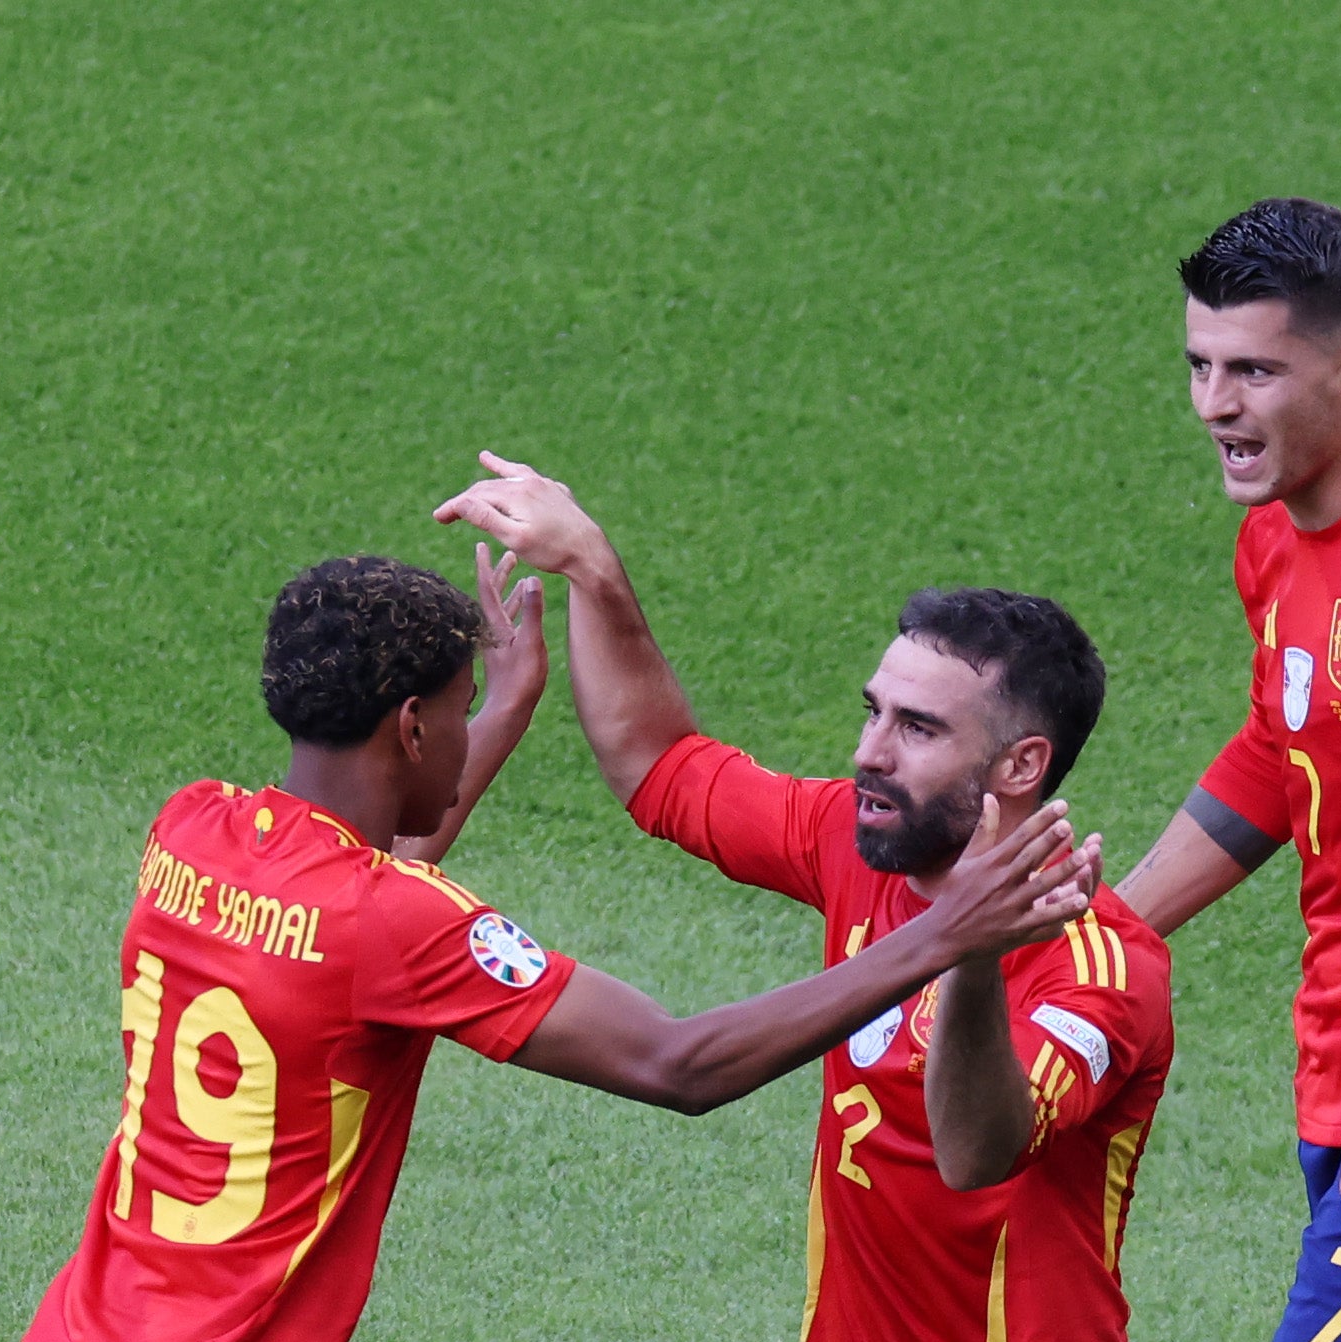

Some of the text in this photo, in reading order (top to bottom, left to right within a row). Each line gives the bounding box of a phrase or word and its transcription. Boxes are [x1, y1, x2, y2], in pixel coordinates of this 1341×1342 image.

[1289, 748, 1321, 856] 7
[211, 883, 324, 963] YAMAL
[113, 950, 277, 1245] 19
[833, 1083, 882, 1190] 2
